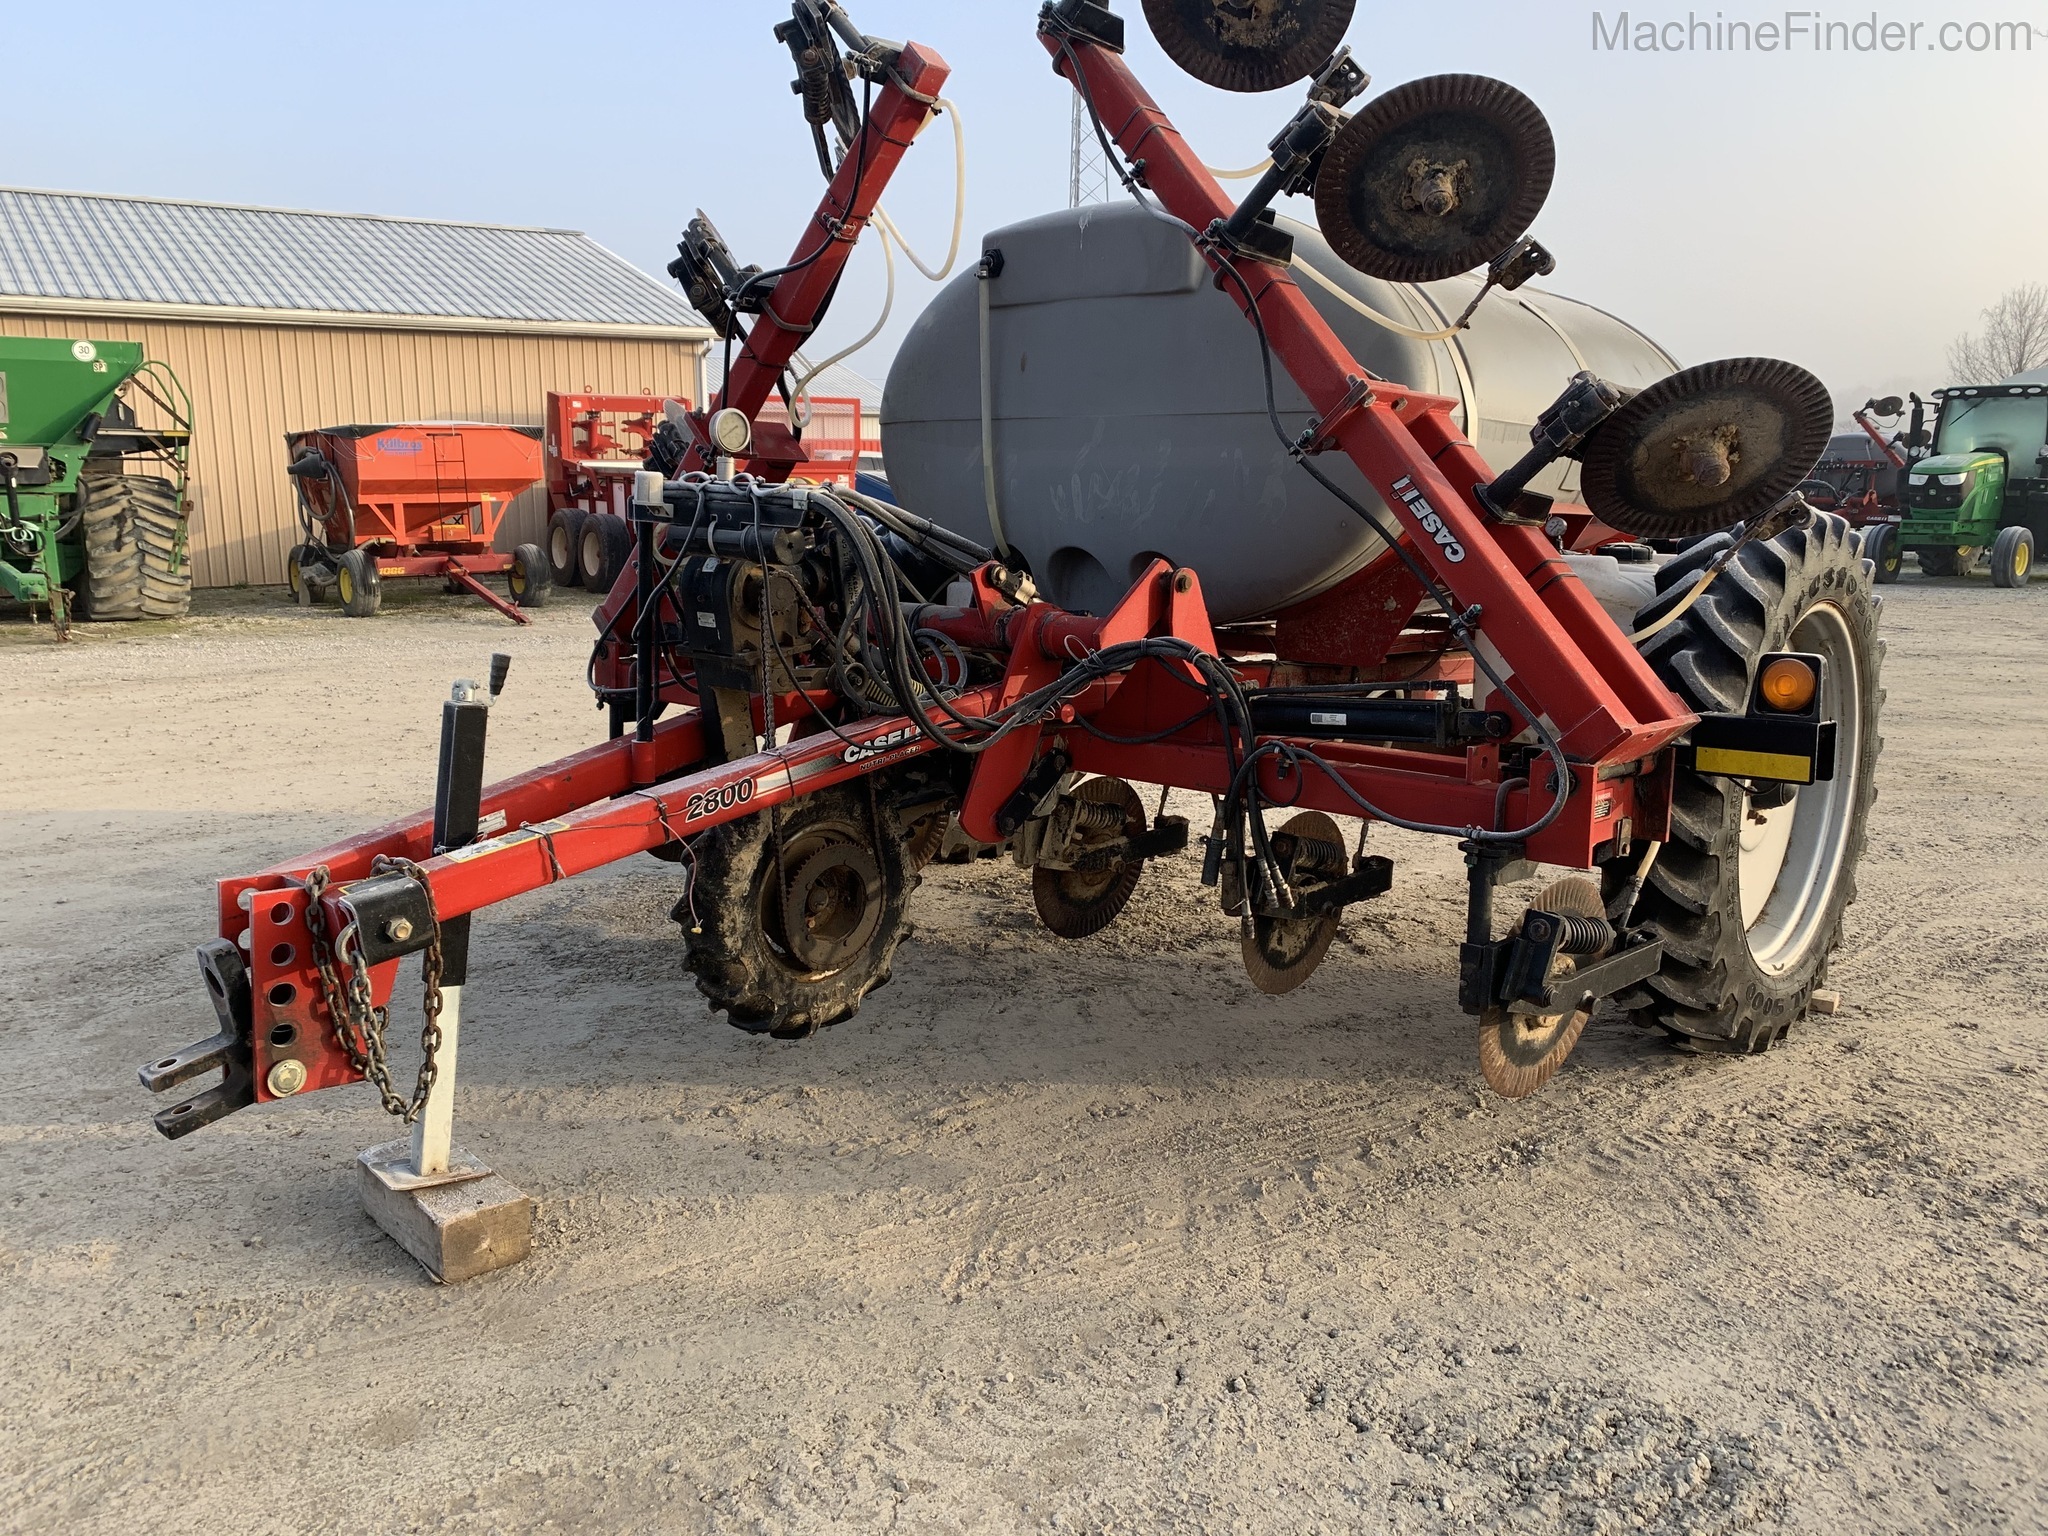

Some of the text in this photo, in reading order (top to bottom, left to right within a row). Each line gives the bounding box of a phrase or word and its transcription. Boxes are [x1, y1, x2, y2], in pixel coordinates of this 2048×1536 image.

[78, 345, 90, 354] 30
[1407, 497, 1466, 563] CASE
[684, 776, 755, 824] 2800
